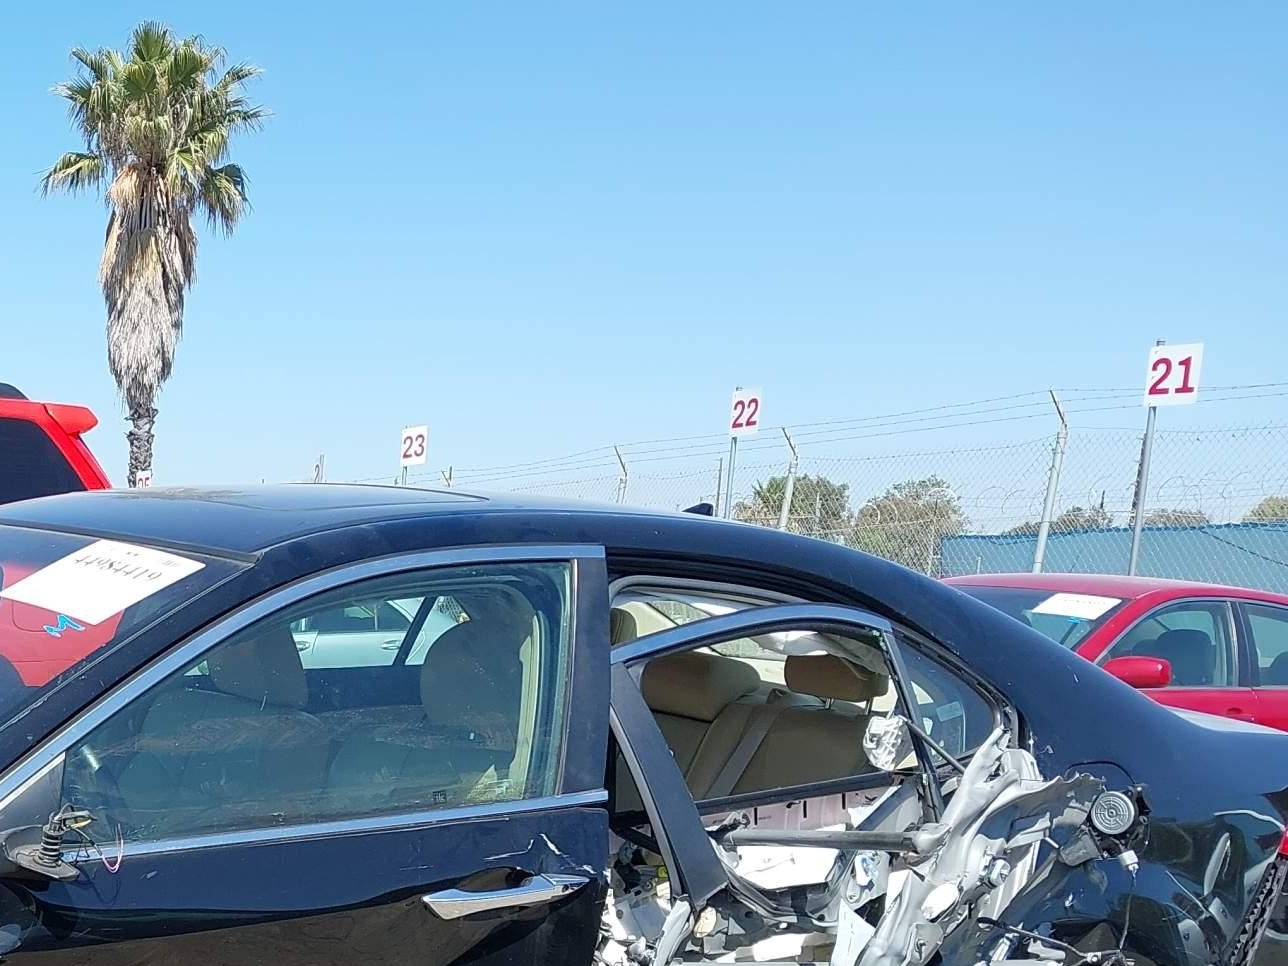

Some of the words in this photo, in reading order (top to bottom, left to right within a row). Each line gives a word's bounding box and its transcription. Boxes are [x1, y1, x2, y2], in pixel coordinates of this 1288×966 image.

[1148, 356, 1195, 395] 21
[731, 398, 759, 429] 22
[402, 433, 425, 459] 23
